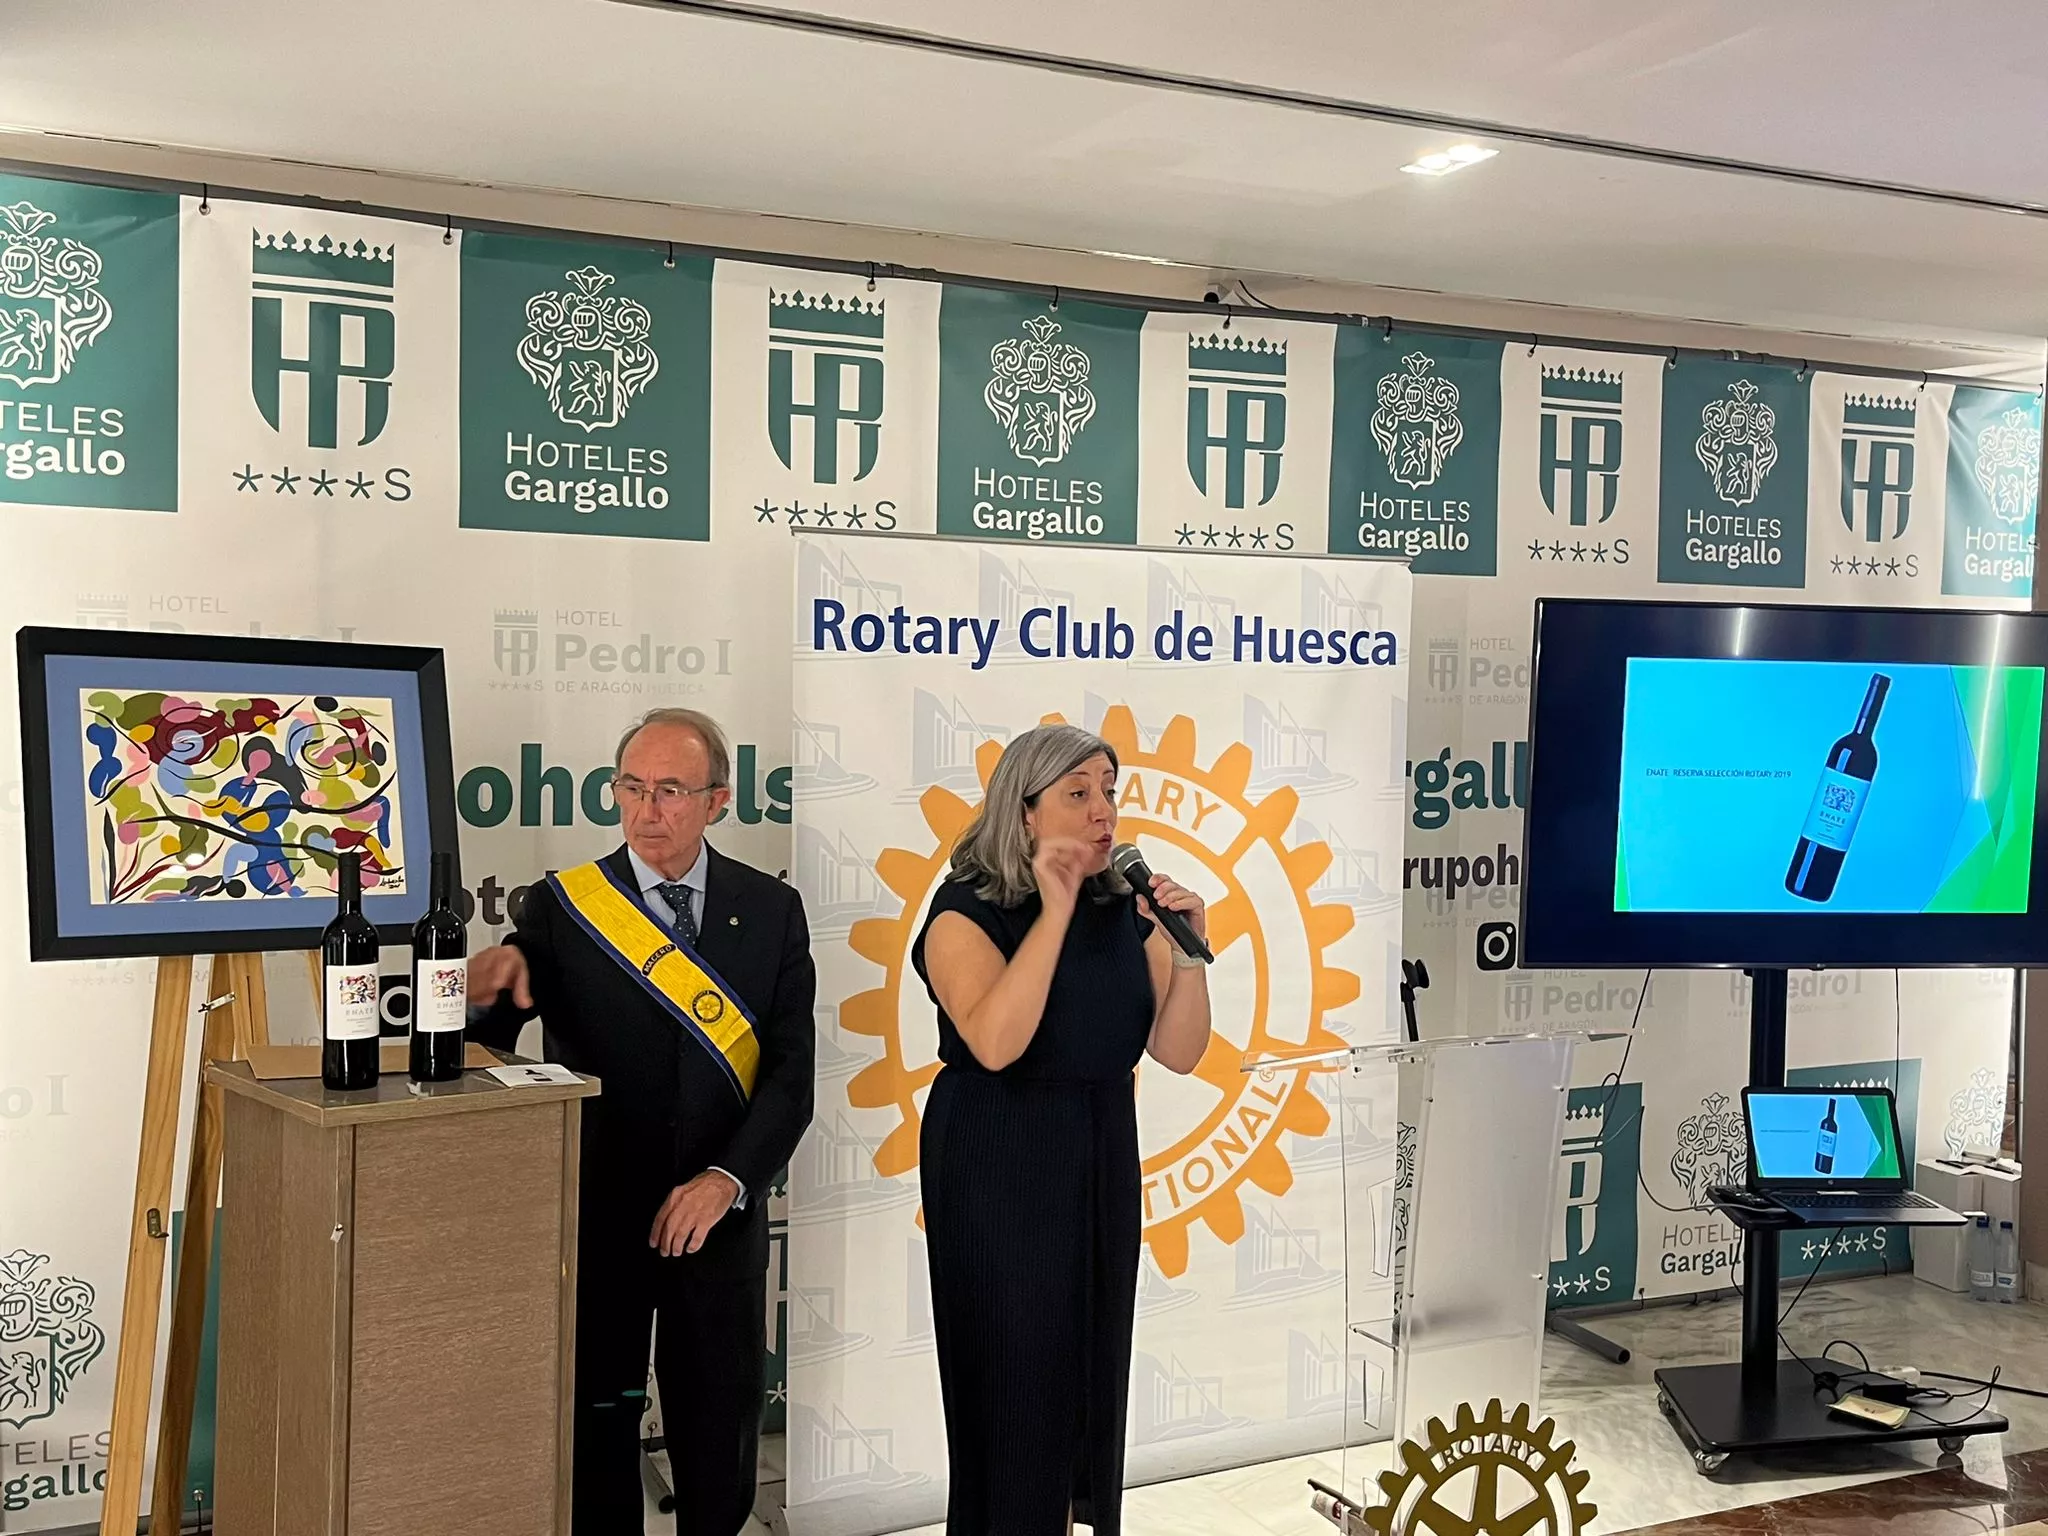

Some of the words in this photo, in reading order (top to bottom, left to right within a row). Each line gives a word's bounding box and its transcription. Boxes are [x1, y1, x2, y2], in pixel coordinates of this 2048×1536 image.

[0, 438, 126, 480] gallo
[506, 431, 669, 475] HOTELES
[504, 470, 670, 513] Gargallo
[974, 467, 1103, 504] HOTELES
[972, 504, 1104, 540] Gargallo
[1360, 491, 1470, 523] HOTELES
[1686, 508, 1782, 539] HOTELES
[1358, 522, 1470, 558] Gargallo
[1684, 536, 1782, 569] Gargallo
[555, 610, 622, 627] HOTEL
[812, 598, 1000, 670] Rotary
[1019, 606, 1135, 660] Club
[1154, 609, 1215, 662] de
[1233, 615, 1398, 667] Huesca
[555, 633, 706, 676] Pedro
[1470, 638, 1514, 651] HOTEL
[1405, 741, 1528, 829] gall
[1773, 770, 1792, 778] 2019
[1542, 979, 1638, 1016] Pedro
[1436, 1432, 1544, 1468] ROTARY
